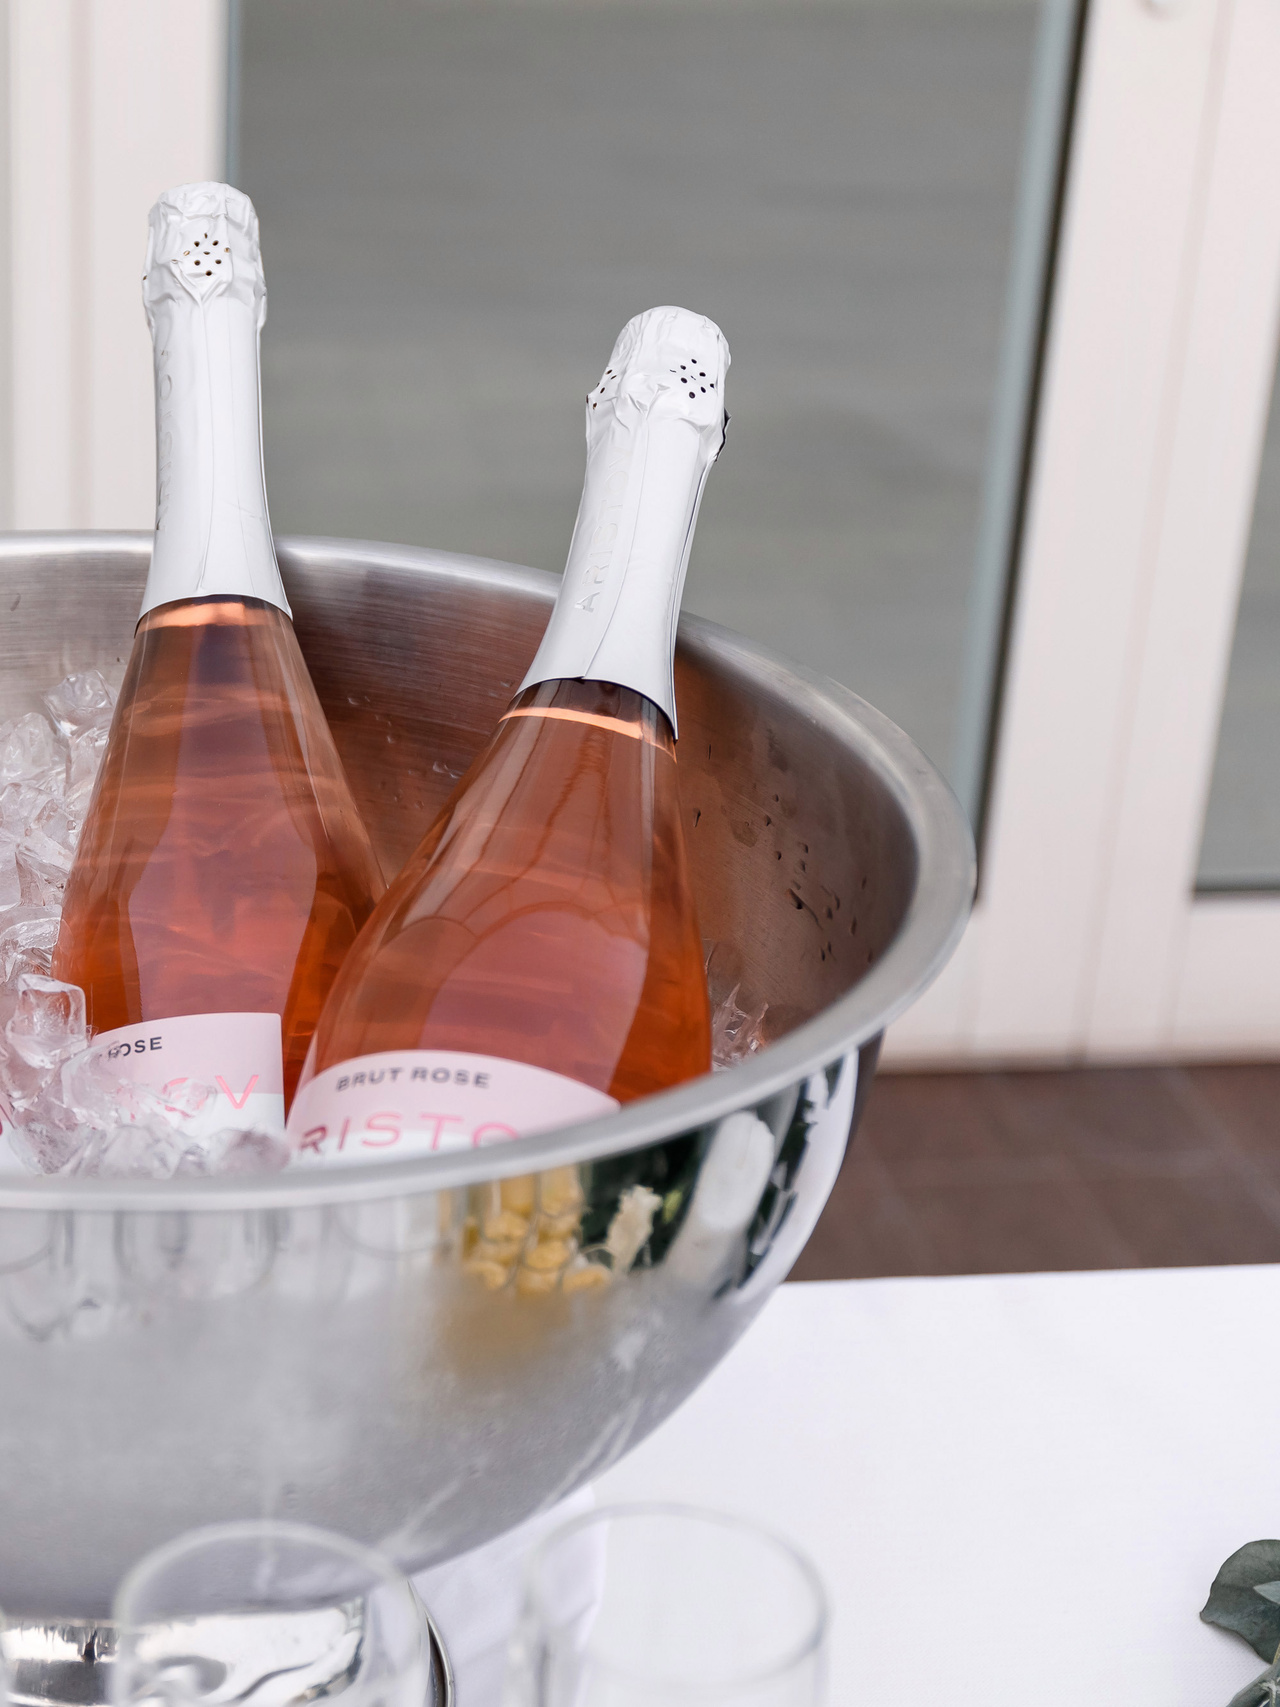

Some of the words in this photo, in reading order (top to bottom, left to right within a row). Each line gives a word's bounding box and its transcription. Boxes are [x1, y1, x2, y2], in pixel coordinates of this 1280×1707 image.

[574, 446, 631, 614] ARISTOV
[335, 1068, 403, 1093] BRUT
[410, 1067, 491, 1089] ROSE
